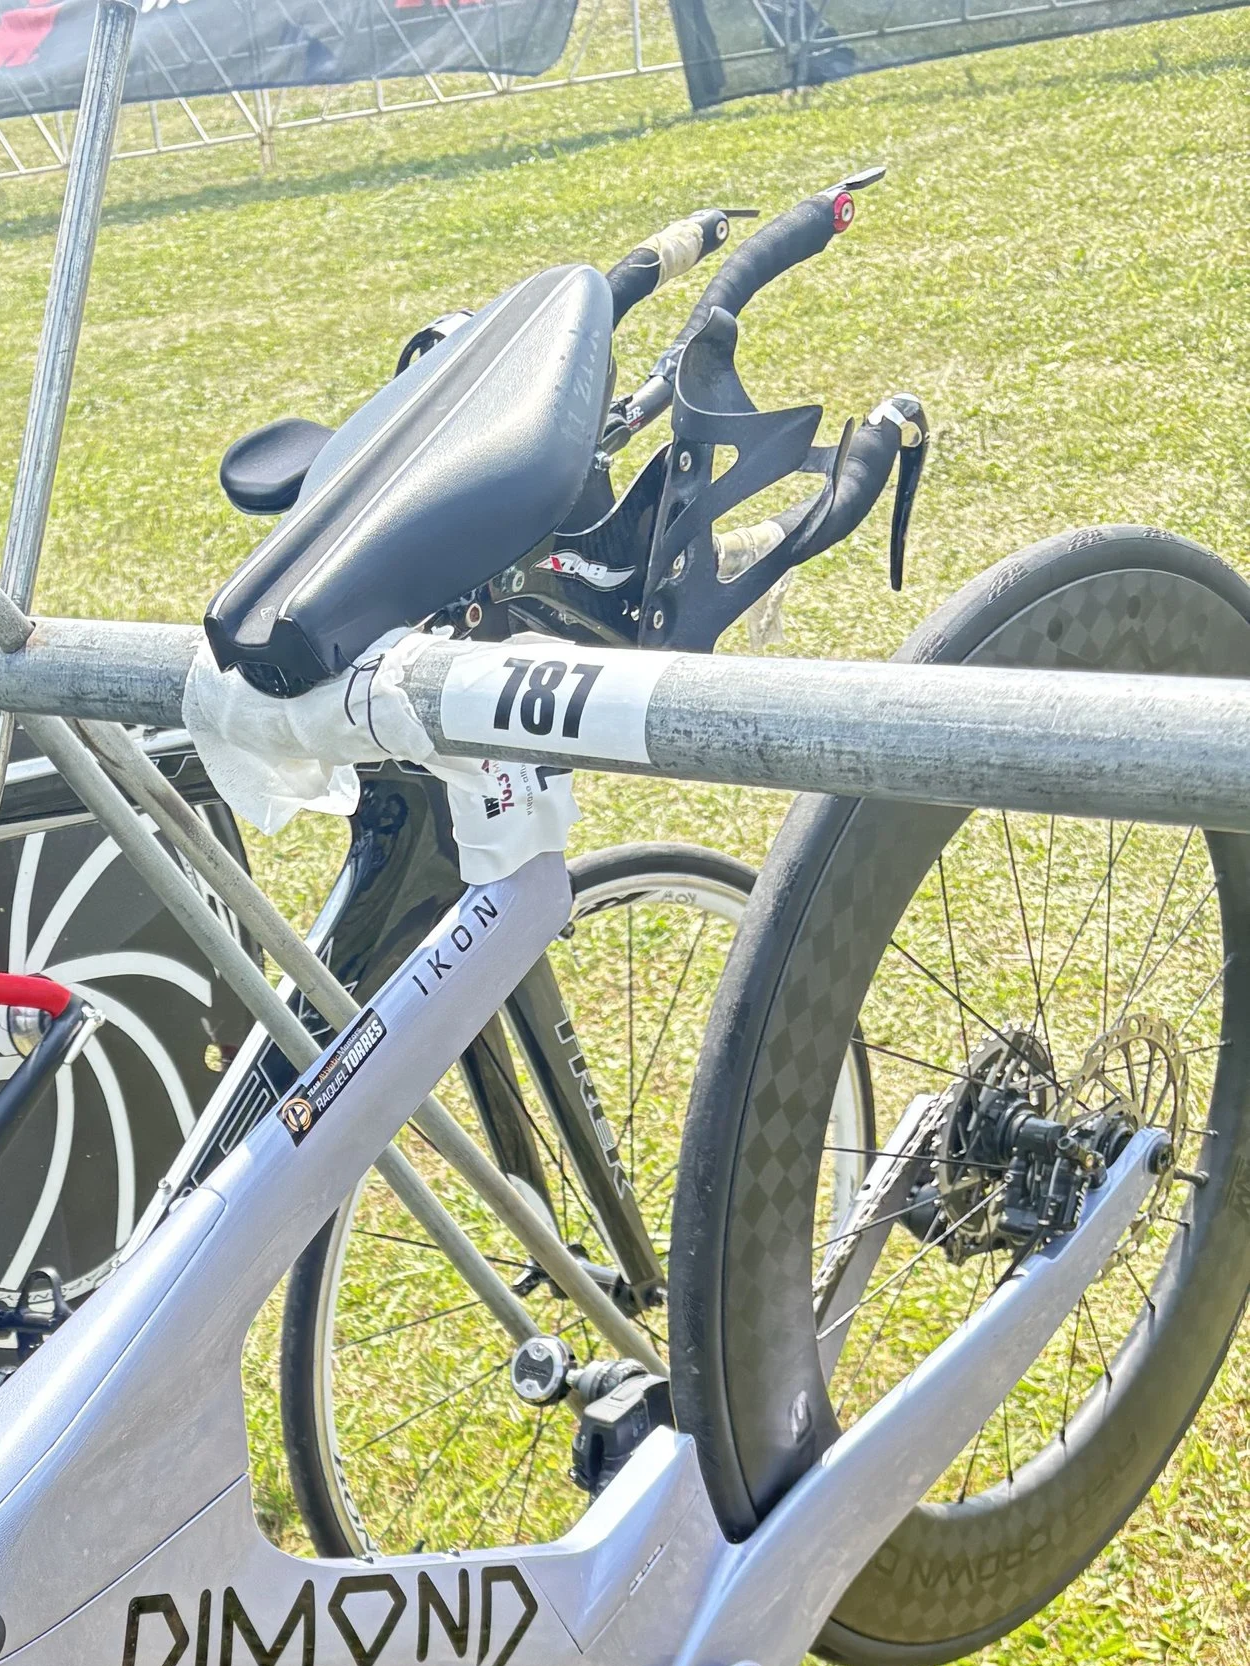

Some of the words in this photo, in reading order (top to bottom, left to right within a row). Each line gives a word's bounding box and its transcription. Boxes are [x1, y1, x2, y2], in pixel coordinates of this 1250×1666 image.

[493, 656, 604, 740] 787
[412, 894, 499, 998] IKON
[306, 1081, 321, 1098] TEAM
[315, 1070, 349, 1112] RAQUEL
[342, 1019, 384, 1073] TORRES
